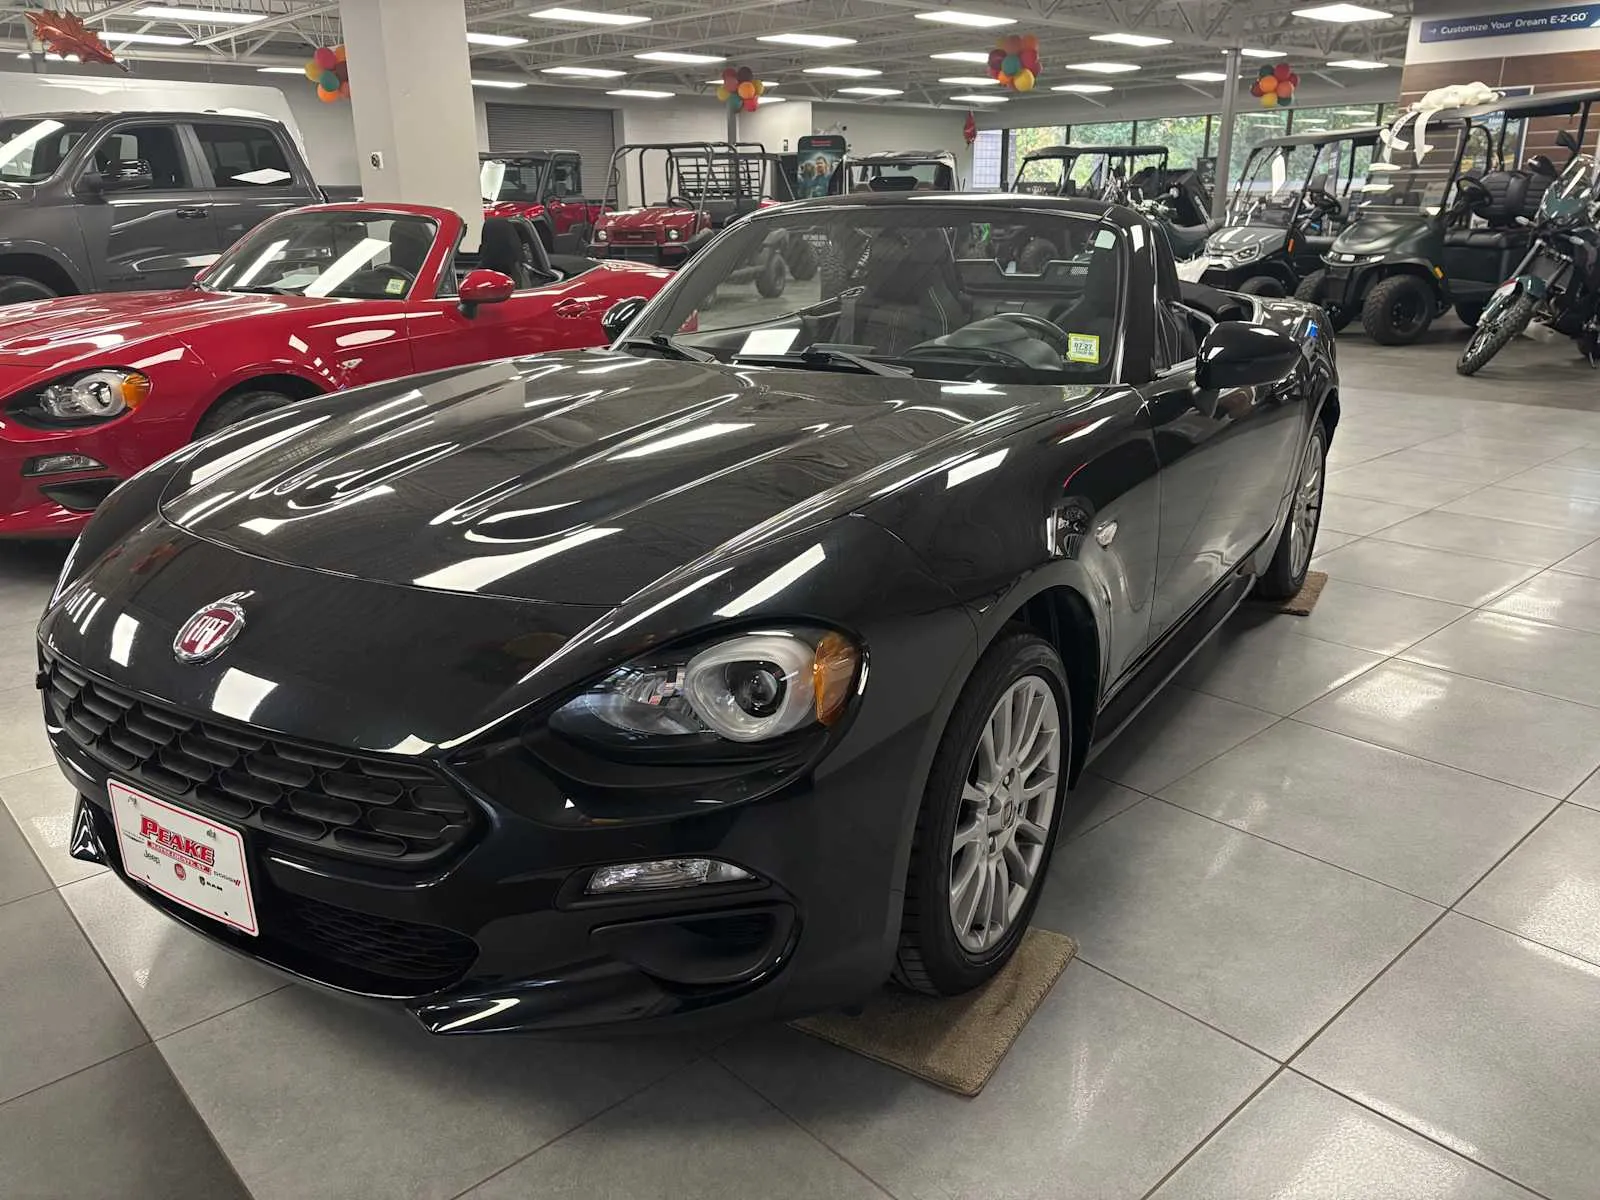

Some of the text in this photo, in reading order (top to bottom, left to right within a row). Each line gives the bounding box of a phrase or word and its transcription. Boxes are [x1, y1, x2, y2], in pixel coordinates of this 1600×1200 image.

[1440, 22, 1489, 35] Customize
[1490, 20, 1513, 30] Your
[1514, 17, 1548, 28] Dream
[184, 615, 230, 646] FIAT
[139, 815, 215, 867] PEAKE
